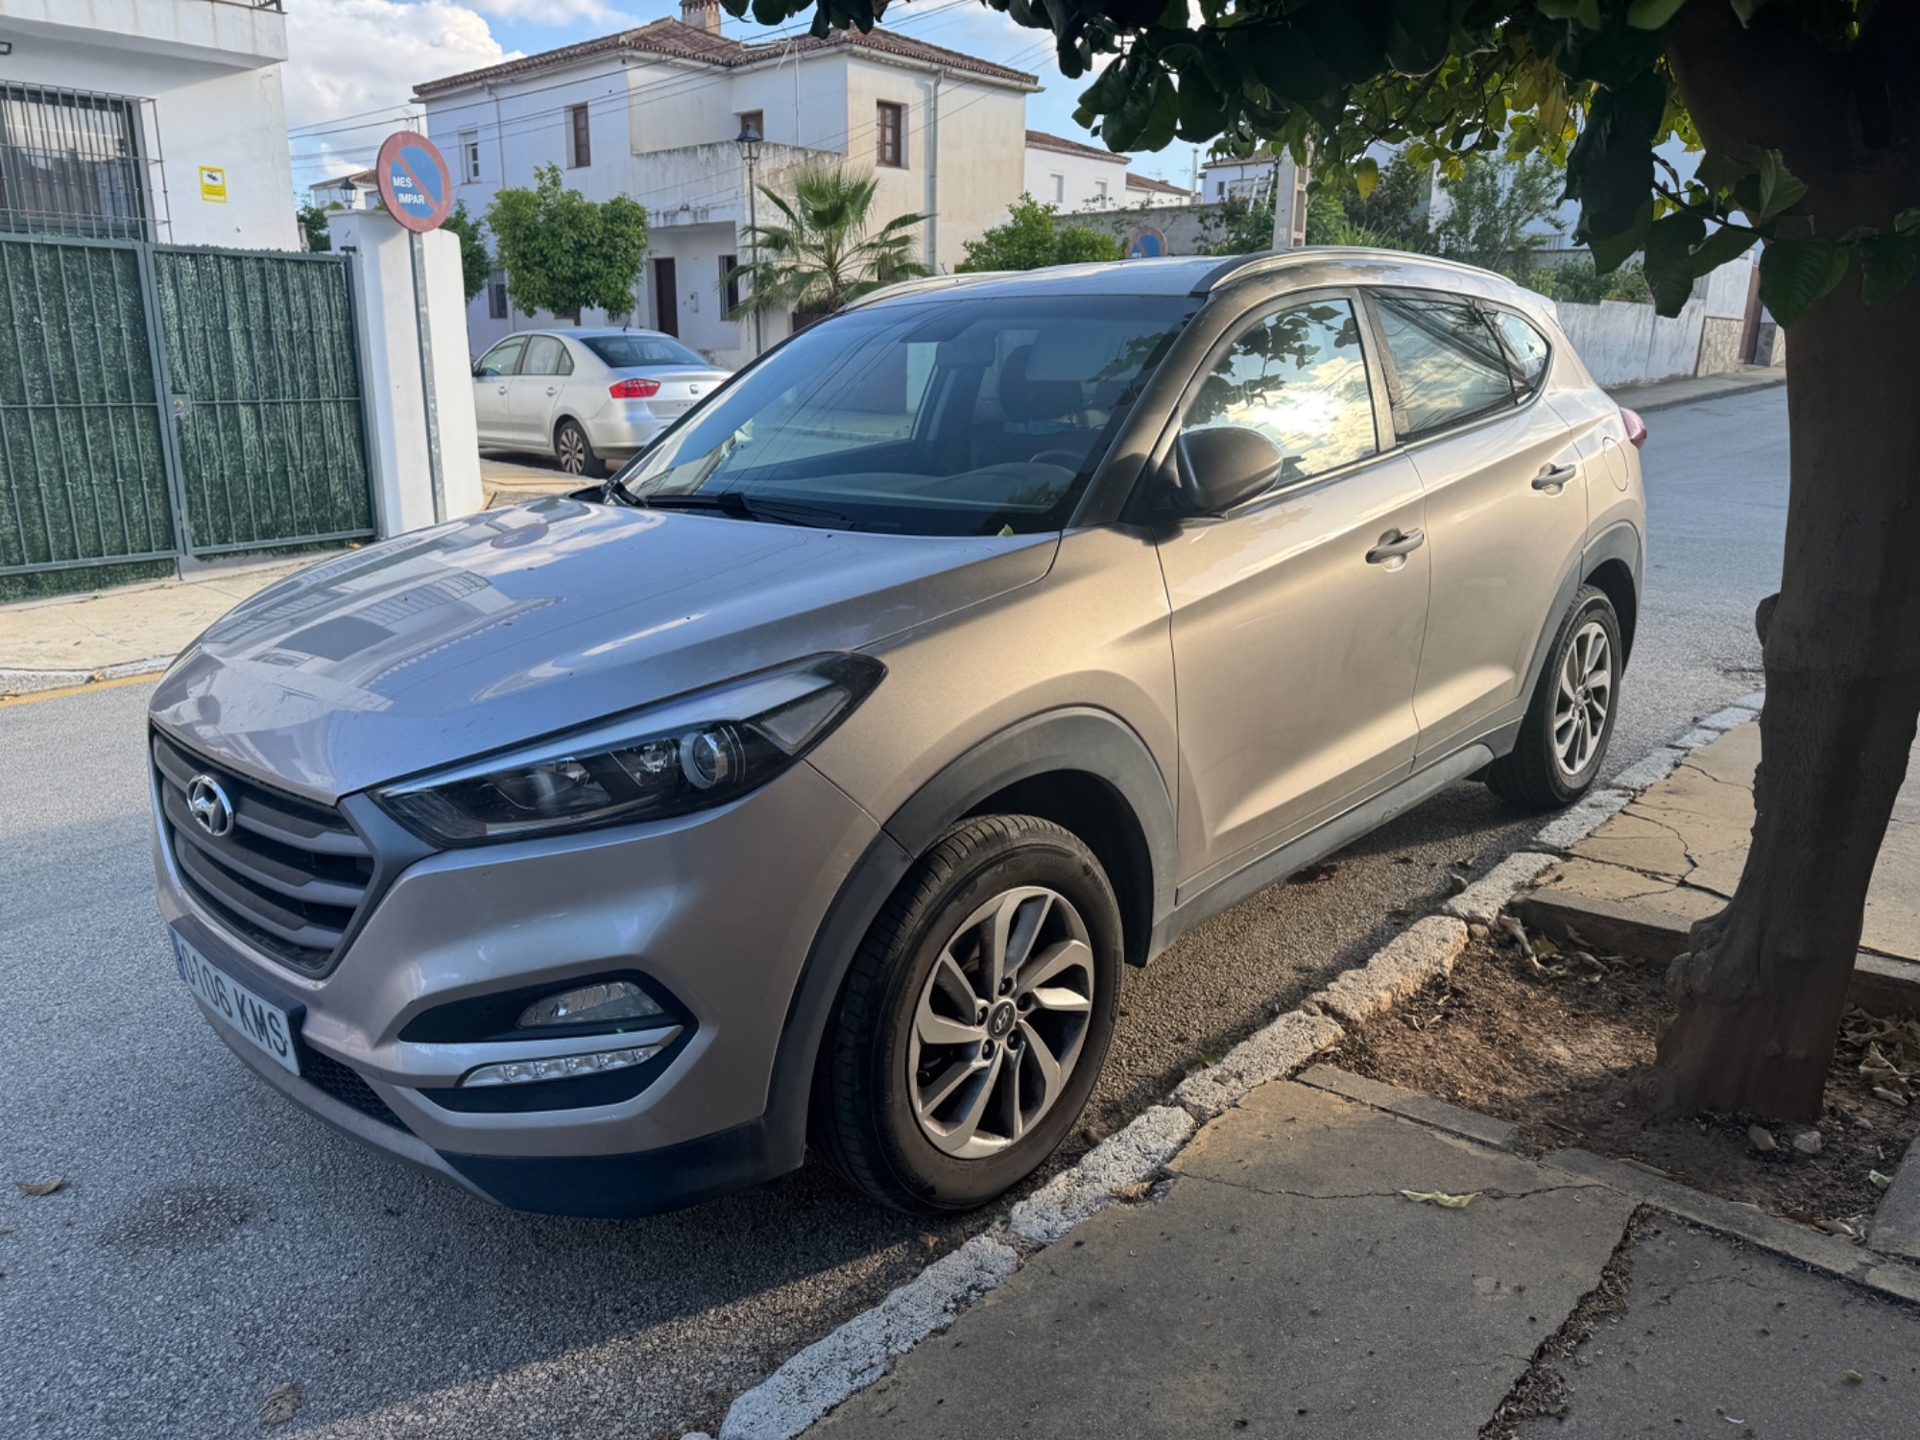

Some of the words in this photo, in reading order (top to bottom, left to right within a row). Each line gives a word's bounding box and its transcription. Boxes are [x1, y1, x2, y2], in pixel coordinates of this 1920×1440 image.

[393, 176, 412, 187] MES
[398, 193, 425, 204] IMPAR
[233, 987, 287, 1057] KMS
